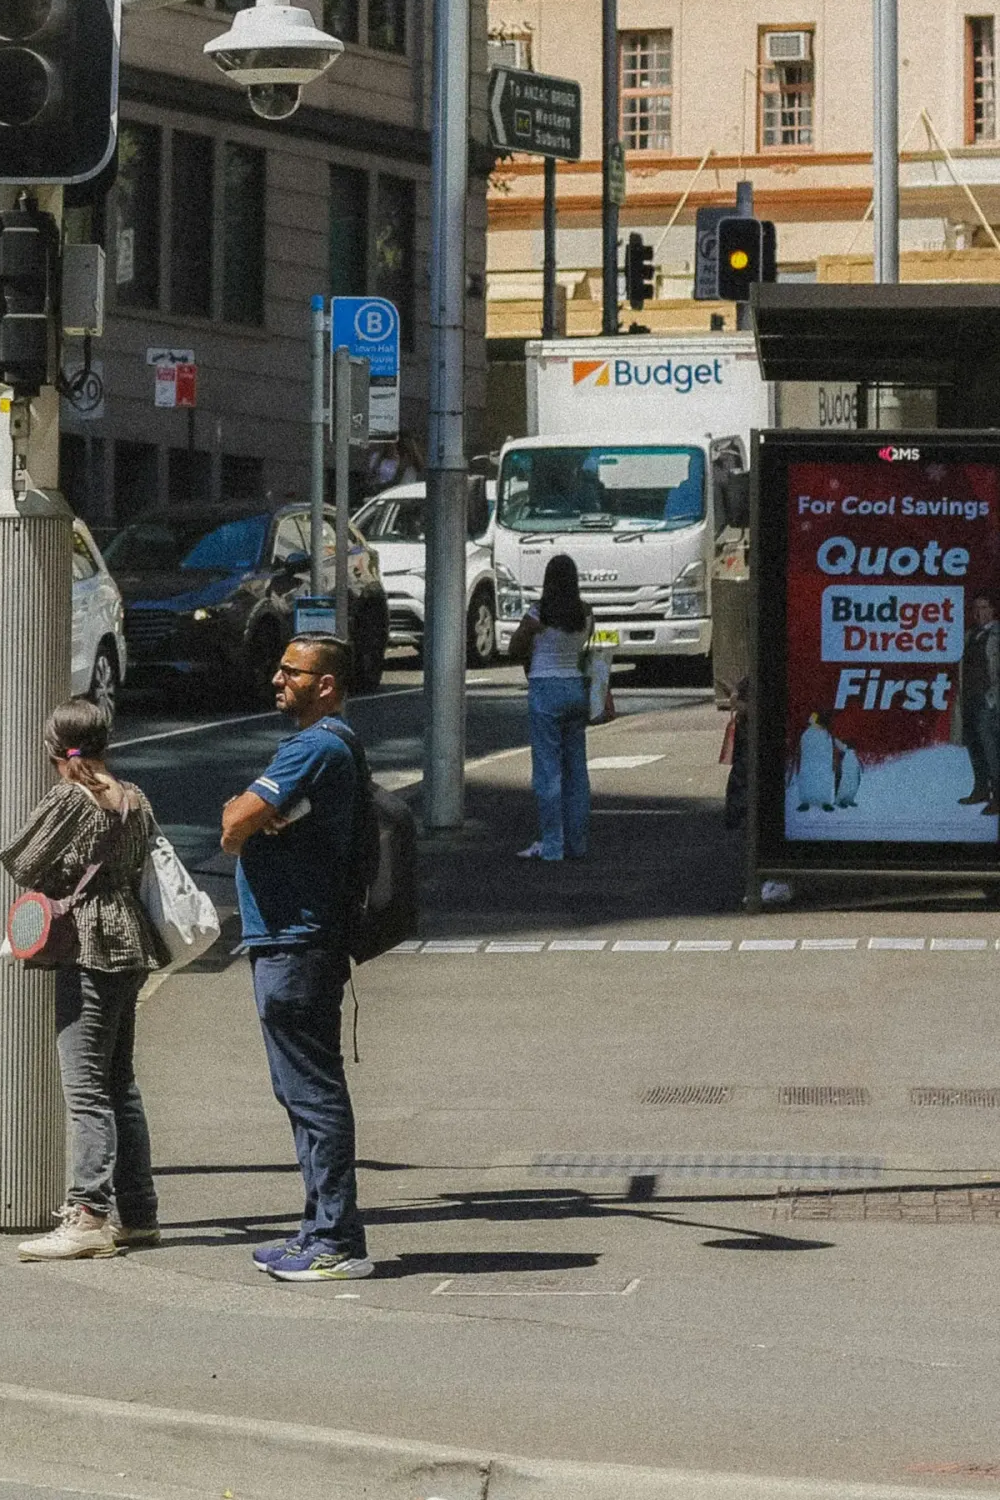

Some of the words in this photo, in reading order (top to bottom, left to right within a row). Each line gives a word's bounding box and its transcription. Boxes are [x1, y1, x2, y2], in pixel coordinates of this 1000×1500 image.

[366, 311, 383, 333] B
[614, 358, 723, 394] Budget
[818, 386, 858, 430] Budge
[798, 496, 835, 515] For
[841, 496, 895, 515] Cool
[902, 496, 990, 520] Savings
[816, 535, 970, 576] Quote
[831, 596, 954, 630] Budget
[843, 625, 948, 652] Direct
[833, 667, 952, 711] First
